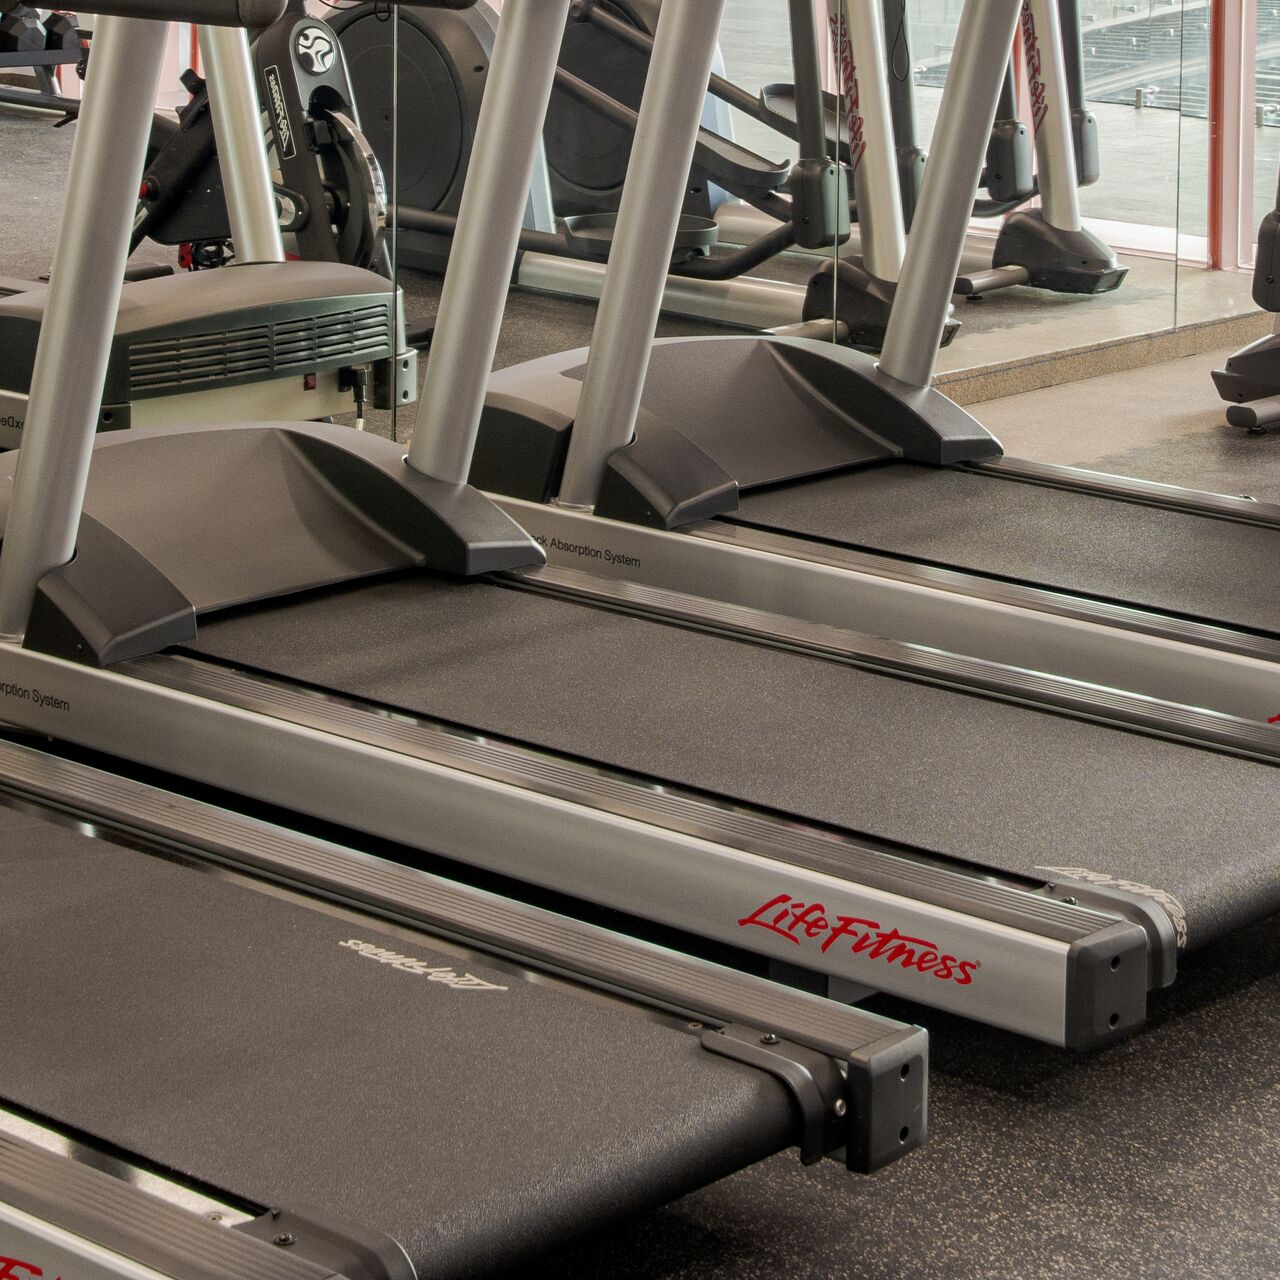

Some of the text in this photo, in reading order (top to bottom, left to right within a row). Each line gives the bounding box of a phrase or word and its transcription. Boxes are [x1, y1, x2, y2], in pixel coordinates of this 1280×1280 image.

[550, 538, 602, 558] Absorption
[604, 549, 641, 568] System
[32, 689, 70, 712] System
